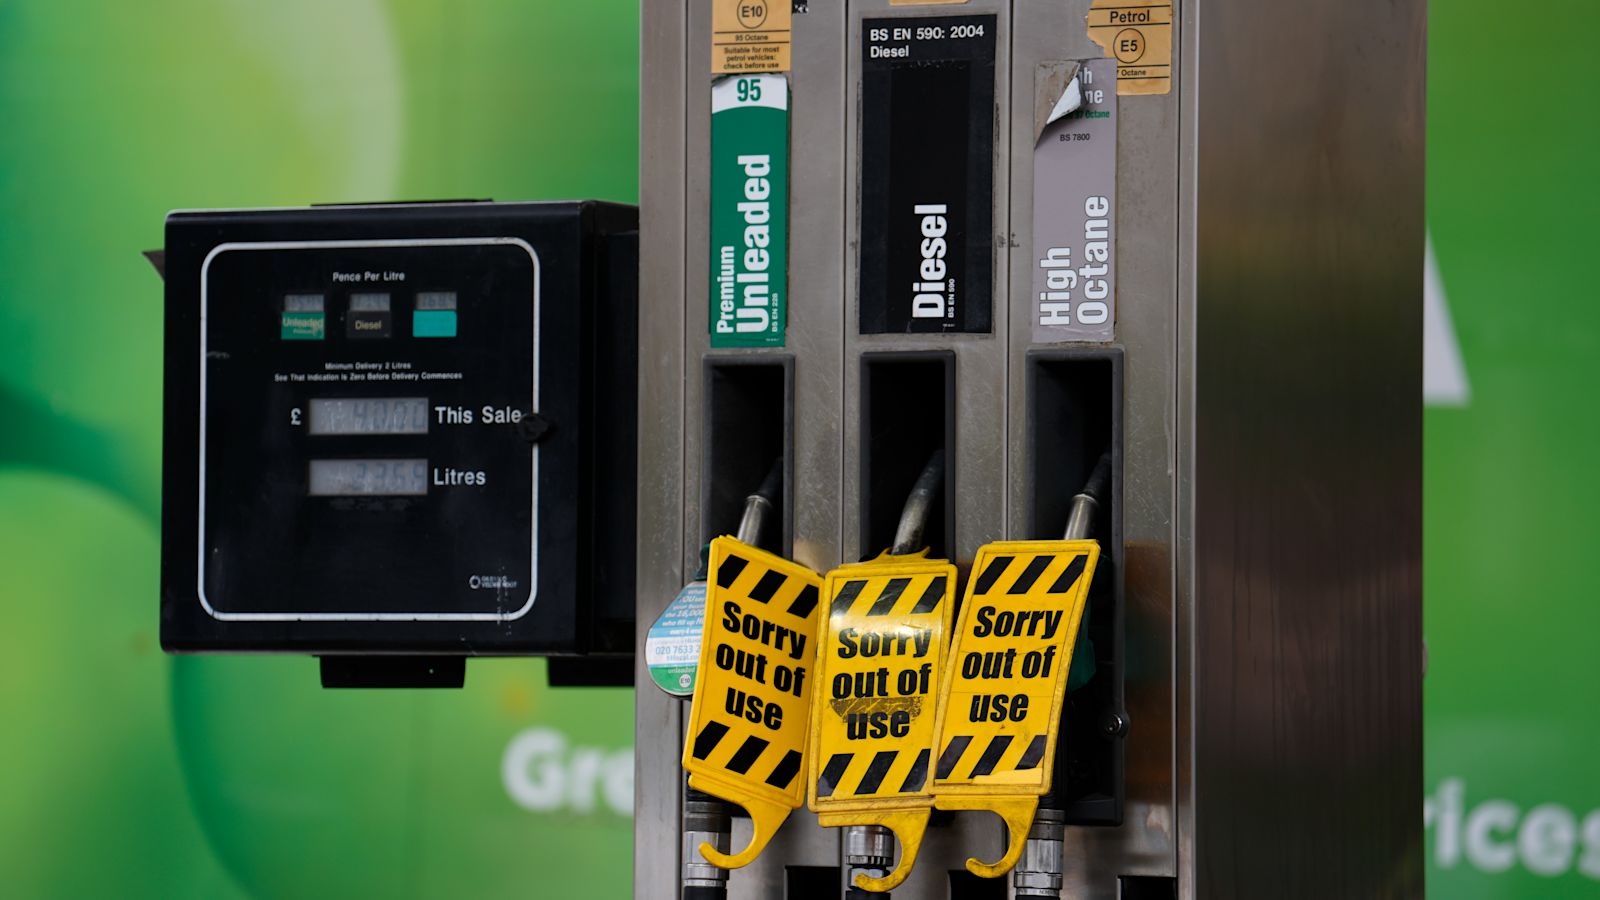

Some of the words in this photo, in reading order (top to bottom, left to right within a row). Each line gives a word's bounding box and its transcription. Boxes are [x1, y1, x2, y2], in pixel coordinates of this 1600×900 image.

[742, 6, 763, 18] E10
[1110, 10, 1150, 23] Petrol
[870, 29, 888, 41] BS
[894, 28, 911, 40] EN
[916, 27, 945, 40] 590:
[950, 25, 984, 38] 2004
[870, 45, 909, 58] Diesel
[1120, 40, 1138, 53] E5
[726, 55, 745, 63] petrol
[1121, 69, 1147, 77] Octane
[737, 79, 762, 102] 95
[1073, 133, 1090, 141] 7800
[736, 154, 771, 333] Unleaded
[912, 204, 948, 318] Diesel
[1076, 196, 1109, 325] Octane
[333, 272, 361, 282] Pence
[364, 271, 380, 281] Per
[384, 271, 405, 281] Litre
[716, 246, 735, 333] Premium
[1039, 247, 1078, 326] High
[948, 294, 955, 305] EN
[948, 307, 955, 318] BS
[355, 320, 382, 330] Diesel
[355, 362, 382, 371] Delivery
[290, 373, 305, 381] That
[307, 373, 339, 381] Indication
[392, 372, 419, 381] Delivery
[421, 372, 462, 380] Commences
[291, 408, 301, 425] £
[435, 406, 473, 424] This
[482, 406, 522, 424] Sale
[434, 468, 486, 485] Litres
[722, 601, 807, 660] Sorry
[973, 606, 1063, 639] Sorry
[656, 646, 671, 655] 020
[838, 627, 932, 659] Sorry
[716, 643, 768, 685] out
[773, 662, 806, 698] of
[962, 648, 1017, 679] out
[1021, 646, 1056, 678] of
[832, 667, 889, 700] out
[897, 663, 932, 696] of
[725, 686, 783, 731] use
[969, 693, 1029, 723] use
[847, 710, 911, 740] use
